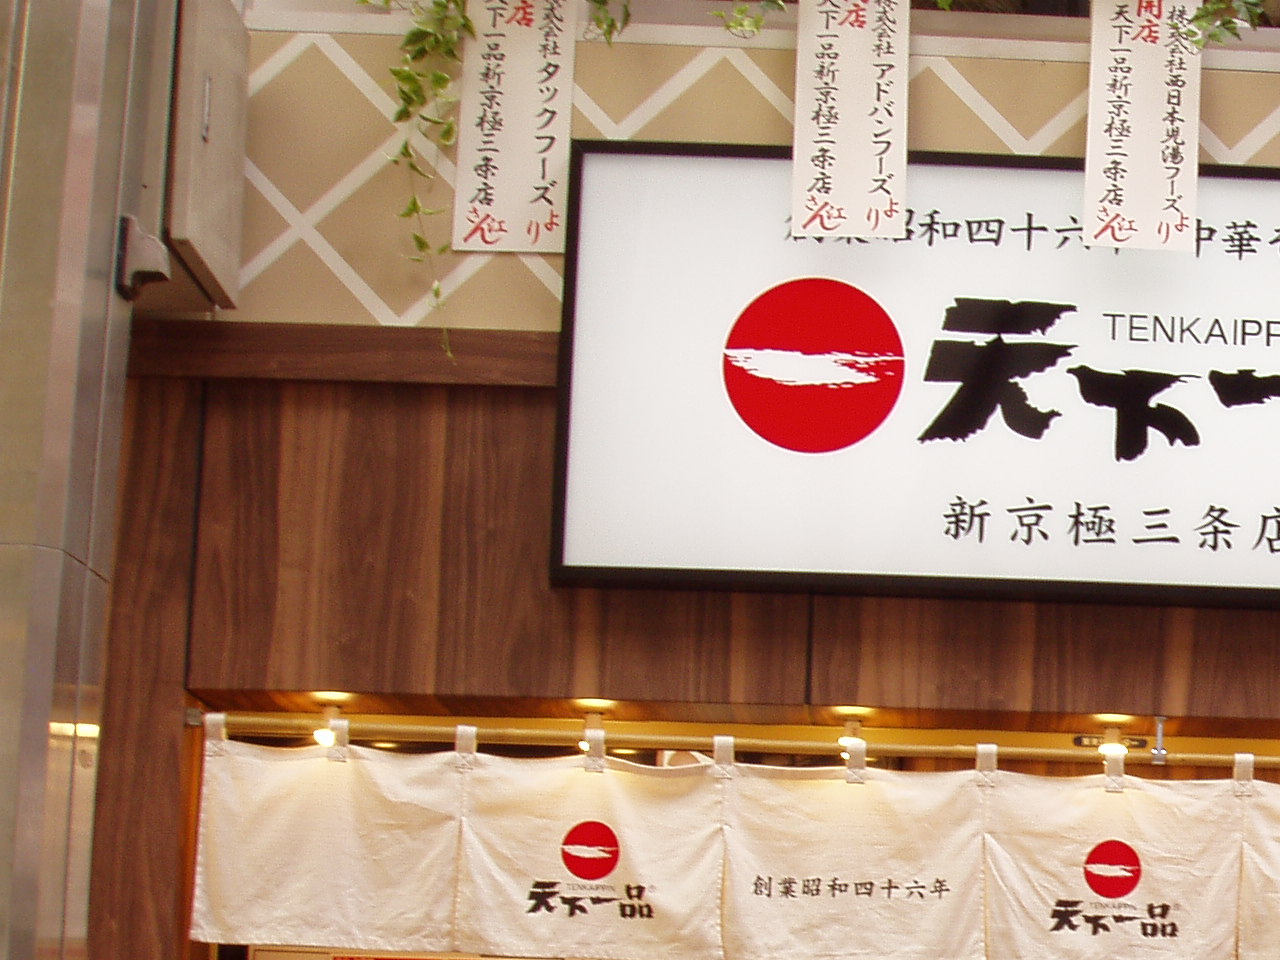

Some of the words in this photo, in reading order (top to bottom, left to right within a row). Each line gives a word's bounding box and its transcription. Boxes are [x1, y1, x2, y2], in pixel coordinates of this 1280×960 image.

[1099, 4, 1135, 206] 天下一品新京極三条店
[526, 881, 655, 919] 天下一品
[751, 875, 952, 901] 創業昭和四十六年
[1049, 899, 1180, 938] 天下一品
